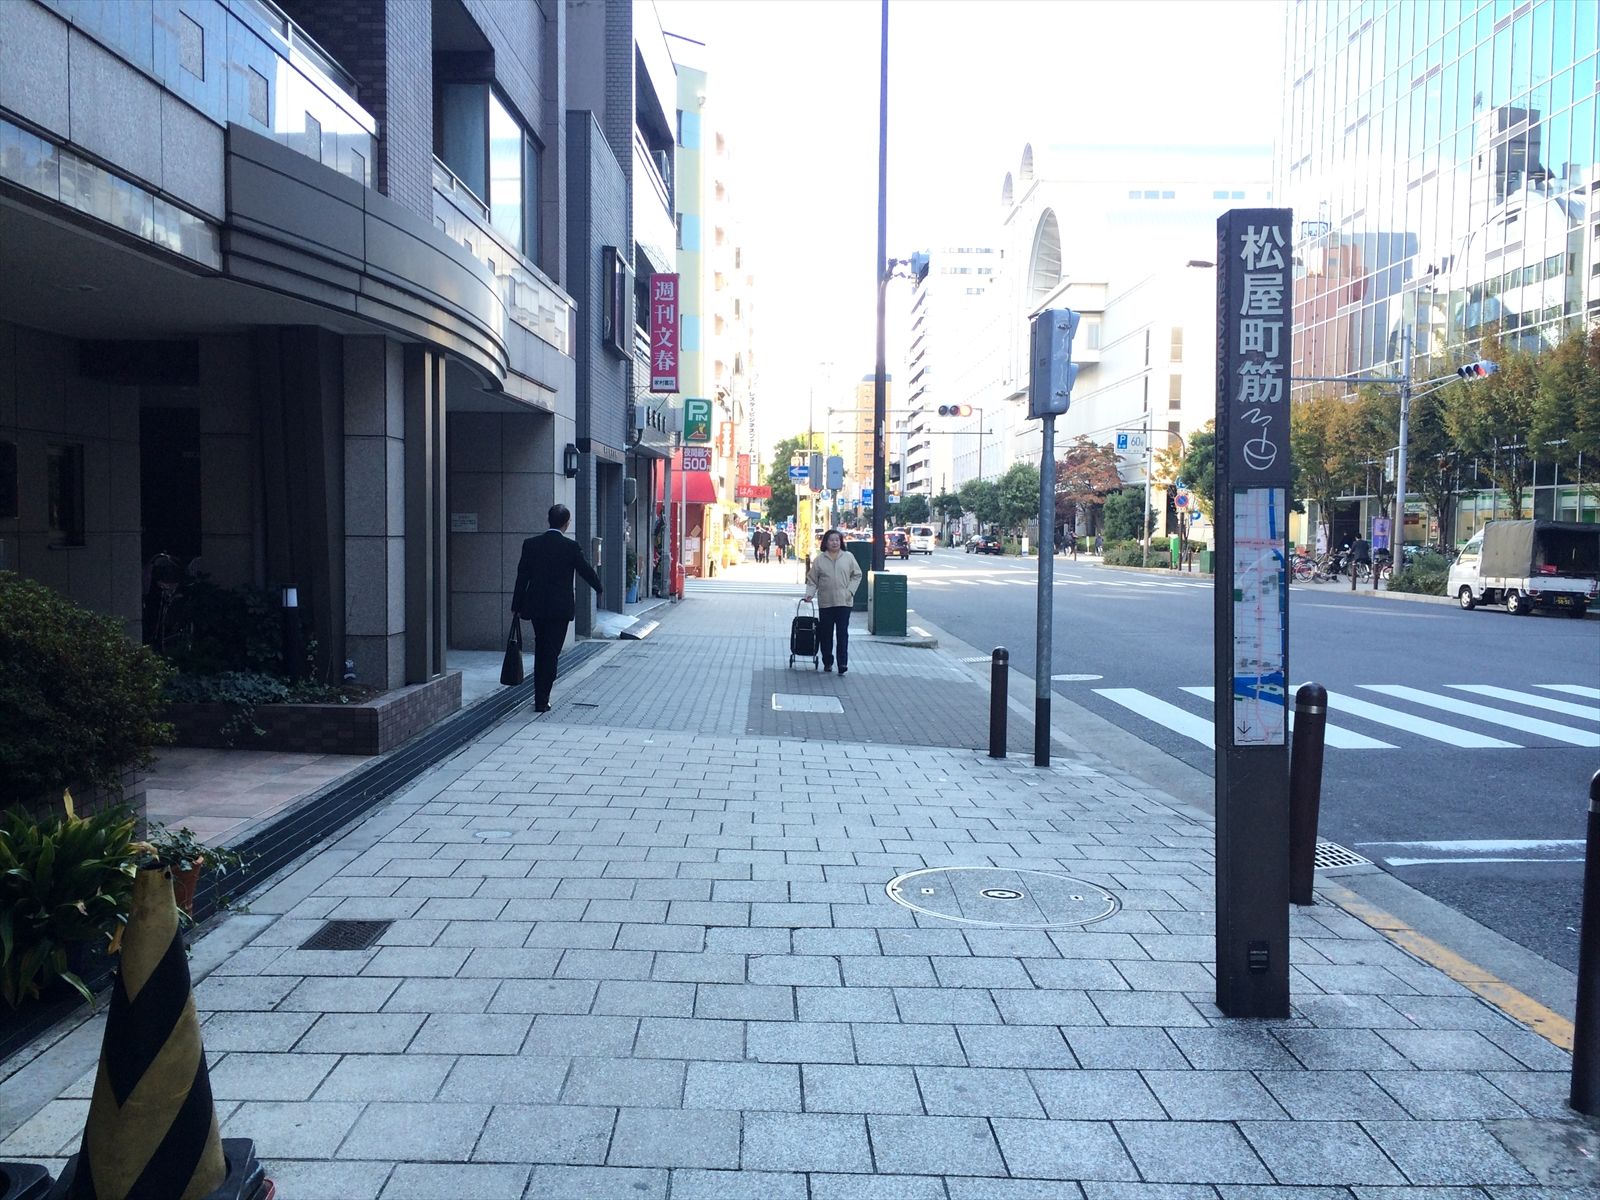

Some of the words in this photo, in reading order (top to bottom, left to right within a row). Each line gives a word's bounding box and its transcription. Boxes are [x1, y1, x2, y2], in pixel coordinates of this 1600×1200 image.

[1238, 225, 1286, 403] 松屋町筋
[653, 281, 676, 371] 週刊文春
[688, 401, 708, 422] P
[695, 414, 708, 422] IN
[684, 448, 711, 458] 夜間最大
